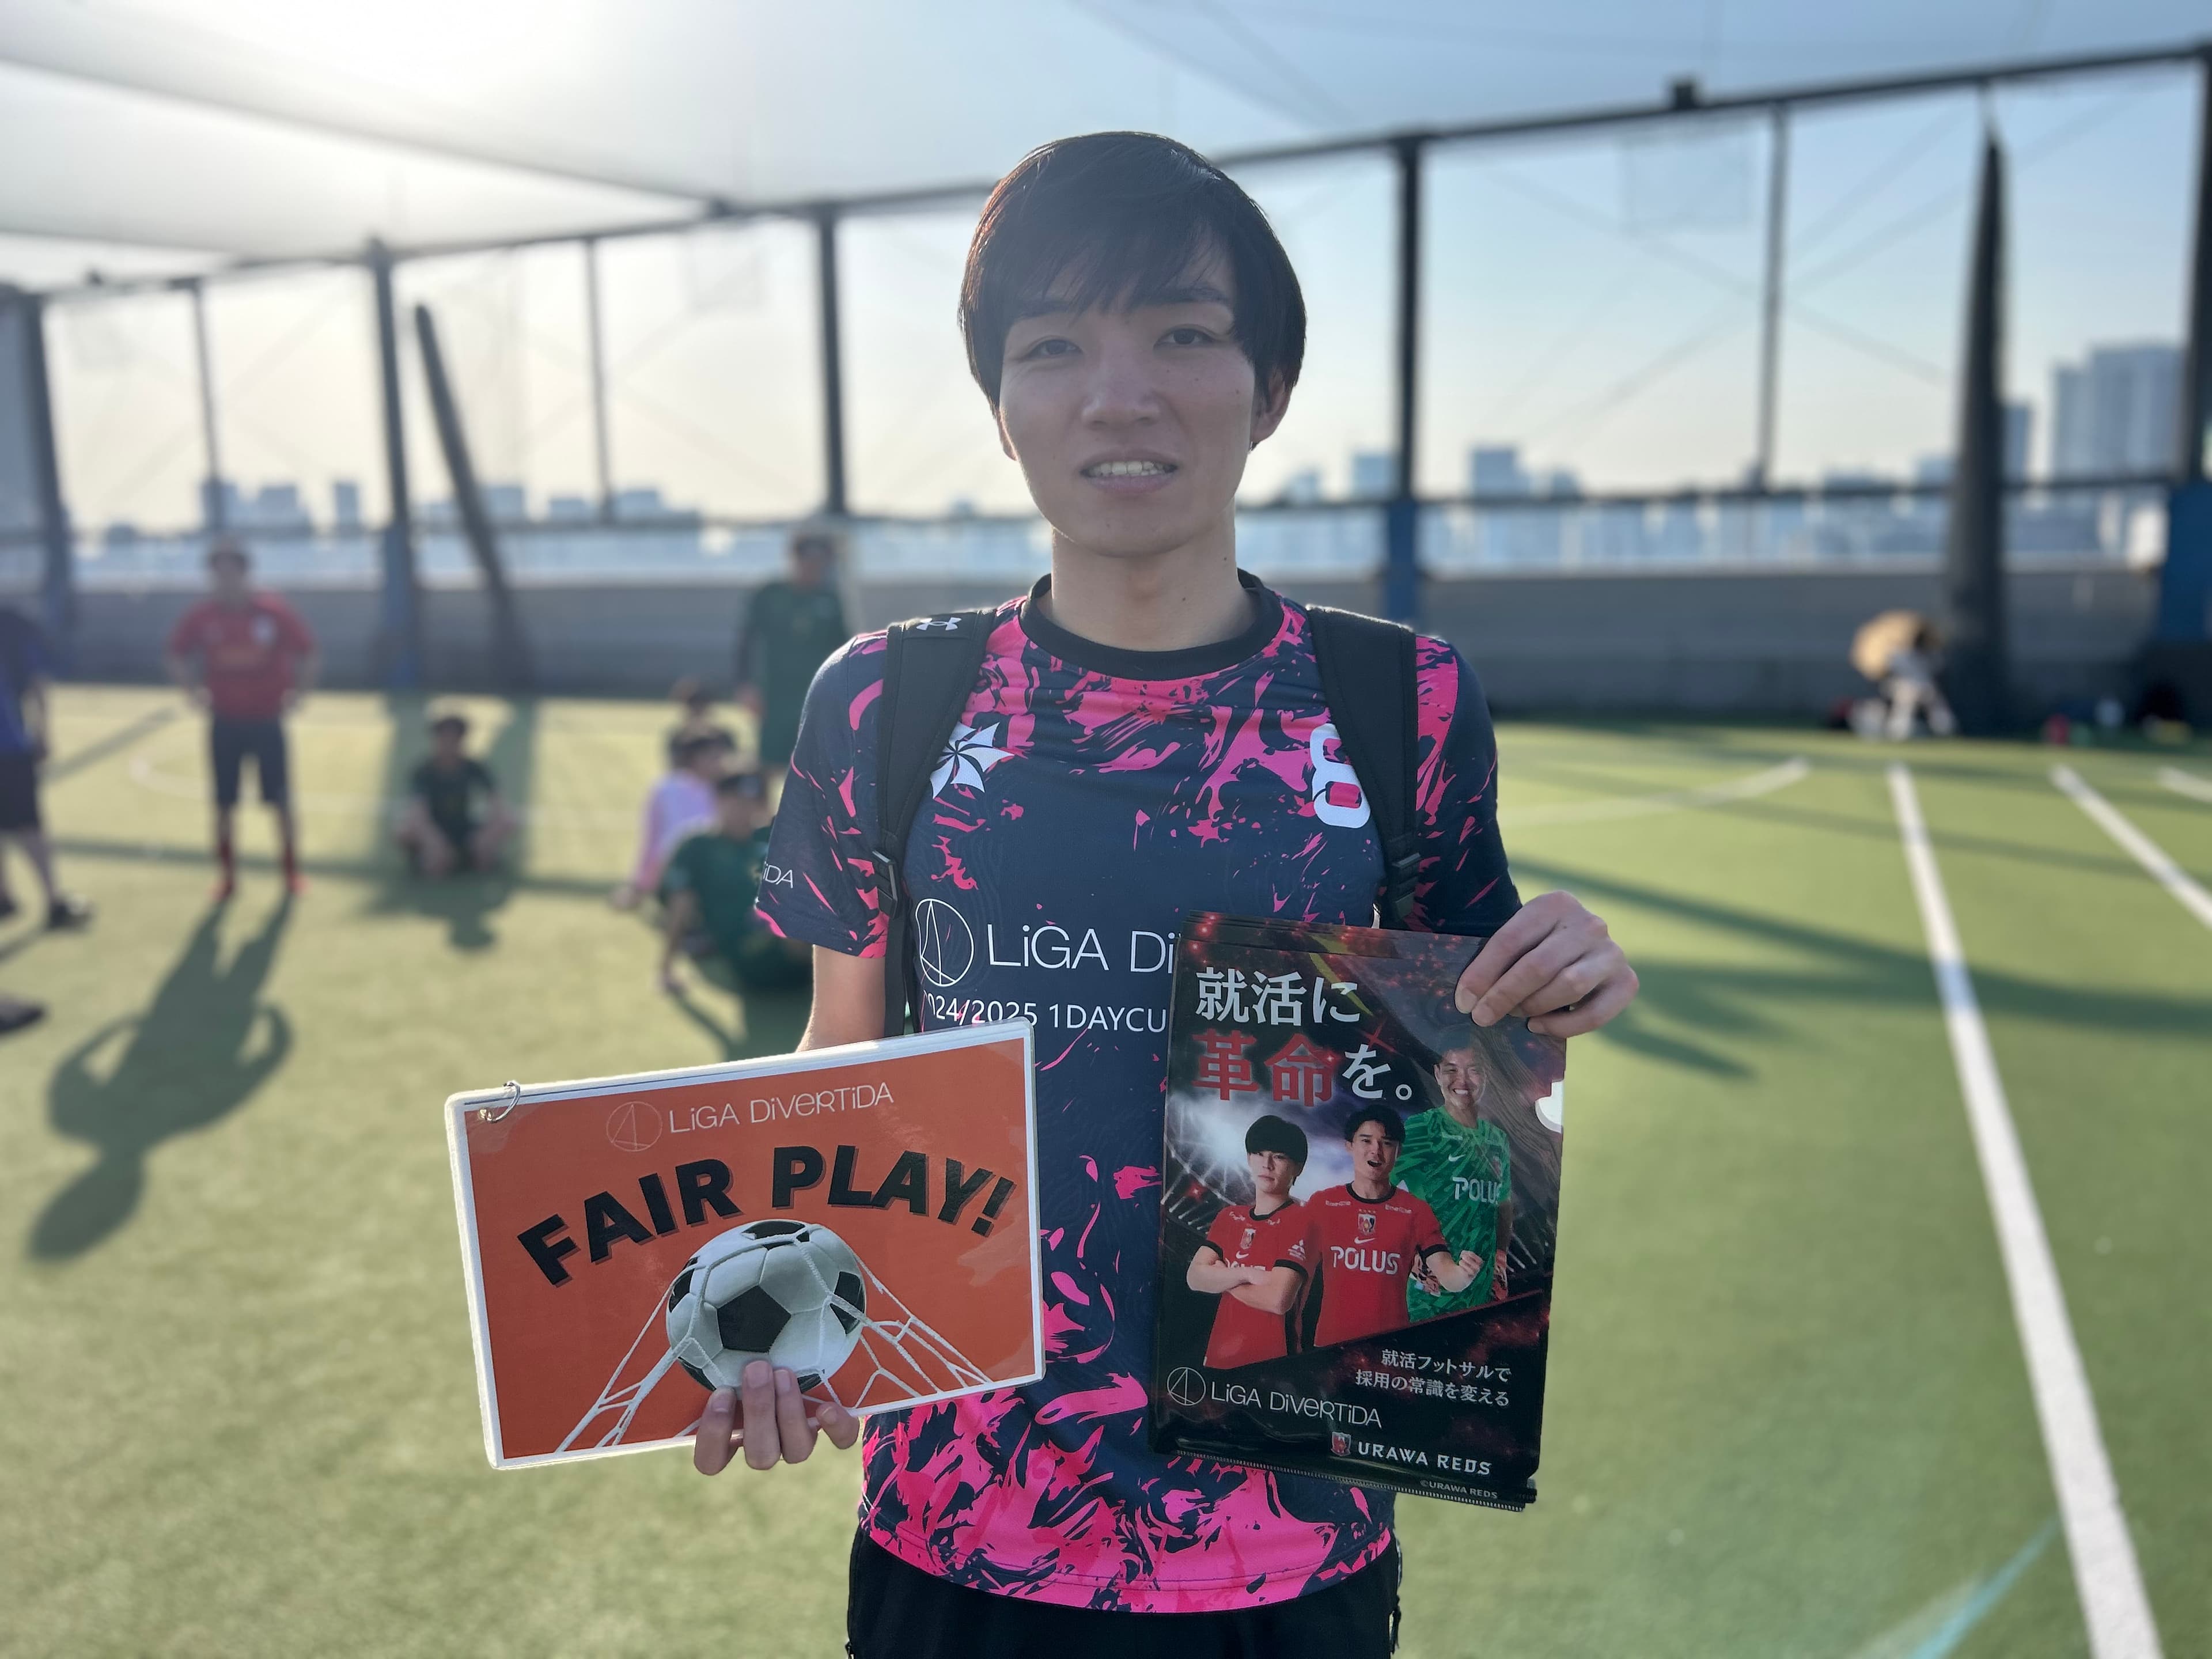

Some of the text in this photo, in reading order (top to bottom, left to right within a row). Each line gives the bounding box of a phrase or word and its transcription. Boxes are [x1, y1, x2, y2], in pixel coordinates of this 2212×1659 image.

[762, 861, 793, 888] iDA
[987, 924, 1181, 974] LiGA Di
[1195, 967, 1360, 1026] 就活に
[669, 1103, 740, 1134] LiGA
[517, 1145, 1017, 1287] FAIR PLAY!
[1330, 1246, 1400, 1275] POLUS
[1381, 1349, 1512, 1382] 就活フットサルで
[1211, 1381, 1262, 1409] LiGA
[1355, 1369, 1510, 1407] 採用の常識を変える
[1358, 1441, 1493, 1476] URAWA REDS
[1469, 1487, 1498, 1499] REDS
